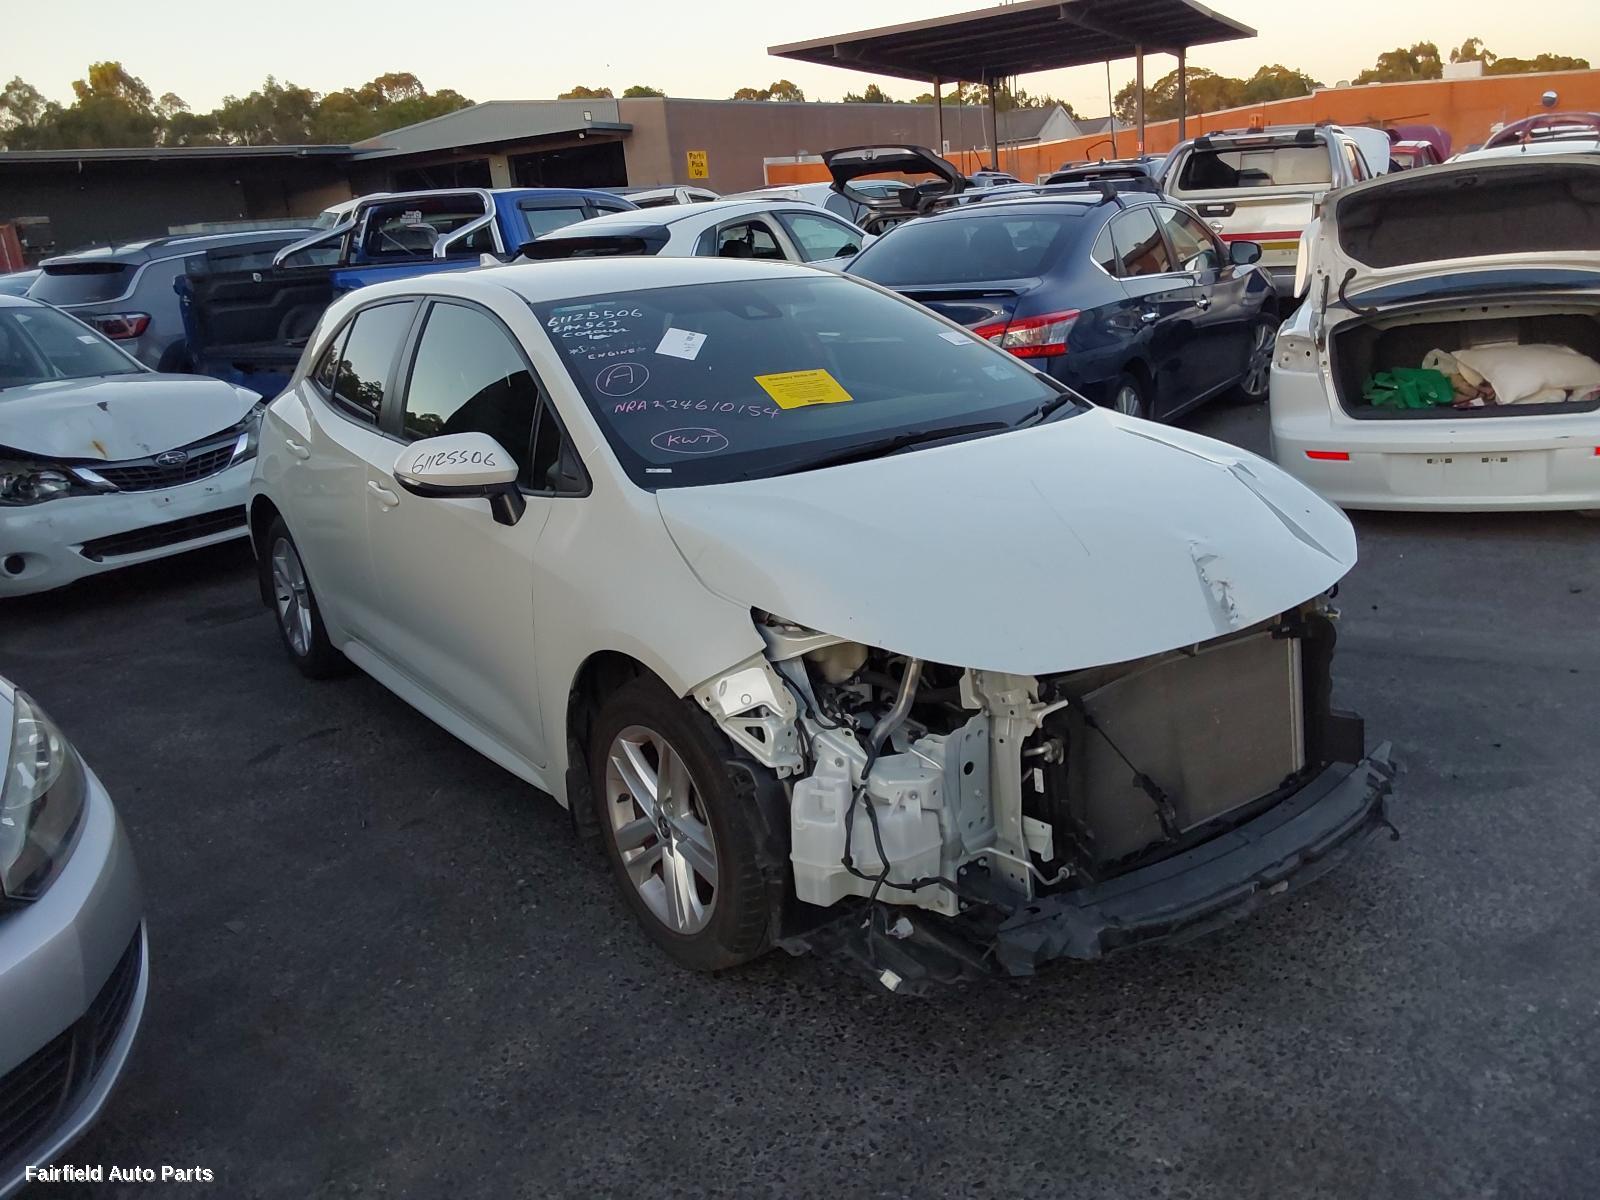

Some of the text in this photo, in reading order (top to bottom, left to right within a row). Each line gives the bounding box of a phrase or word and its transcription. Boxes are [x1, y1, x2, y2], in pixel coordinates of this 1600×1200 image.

[547, 308, 643, 327] 61125506
[605, 365, 634, 387] A
[667, 434, 718, 447] KWT
[411, 450, 496, 475] 61125506
